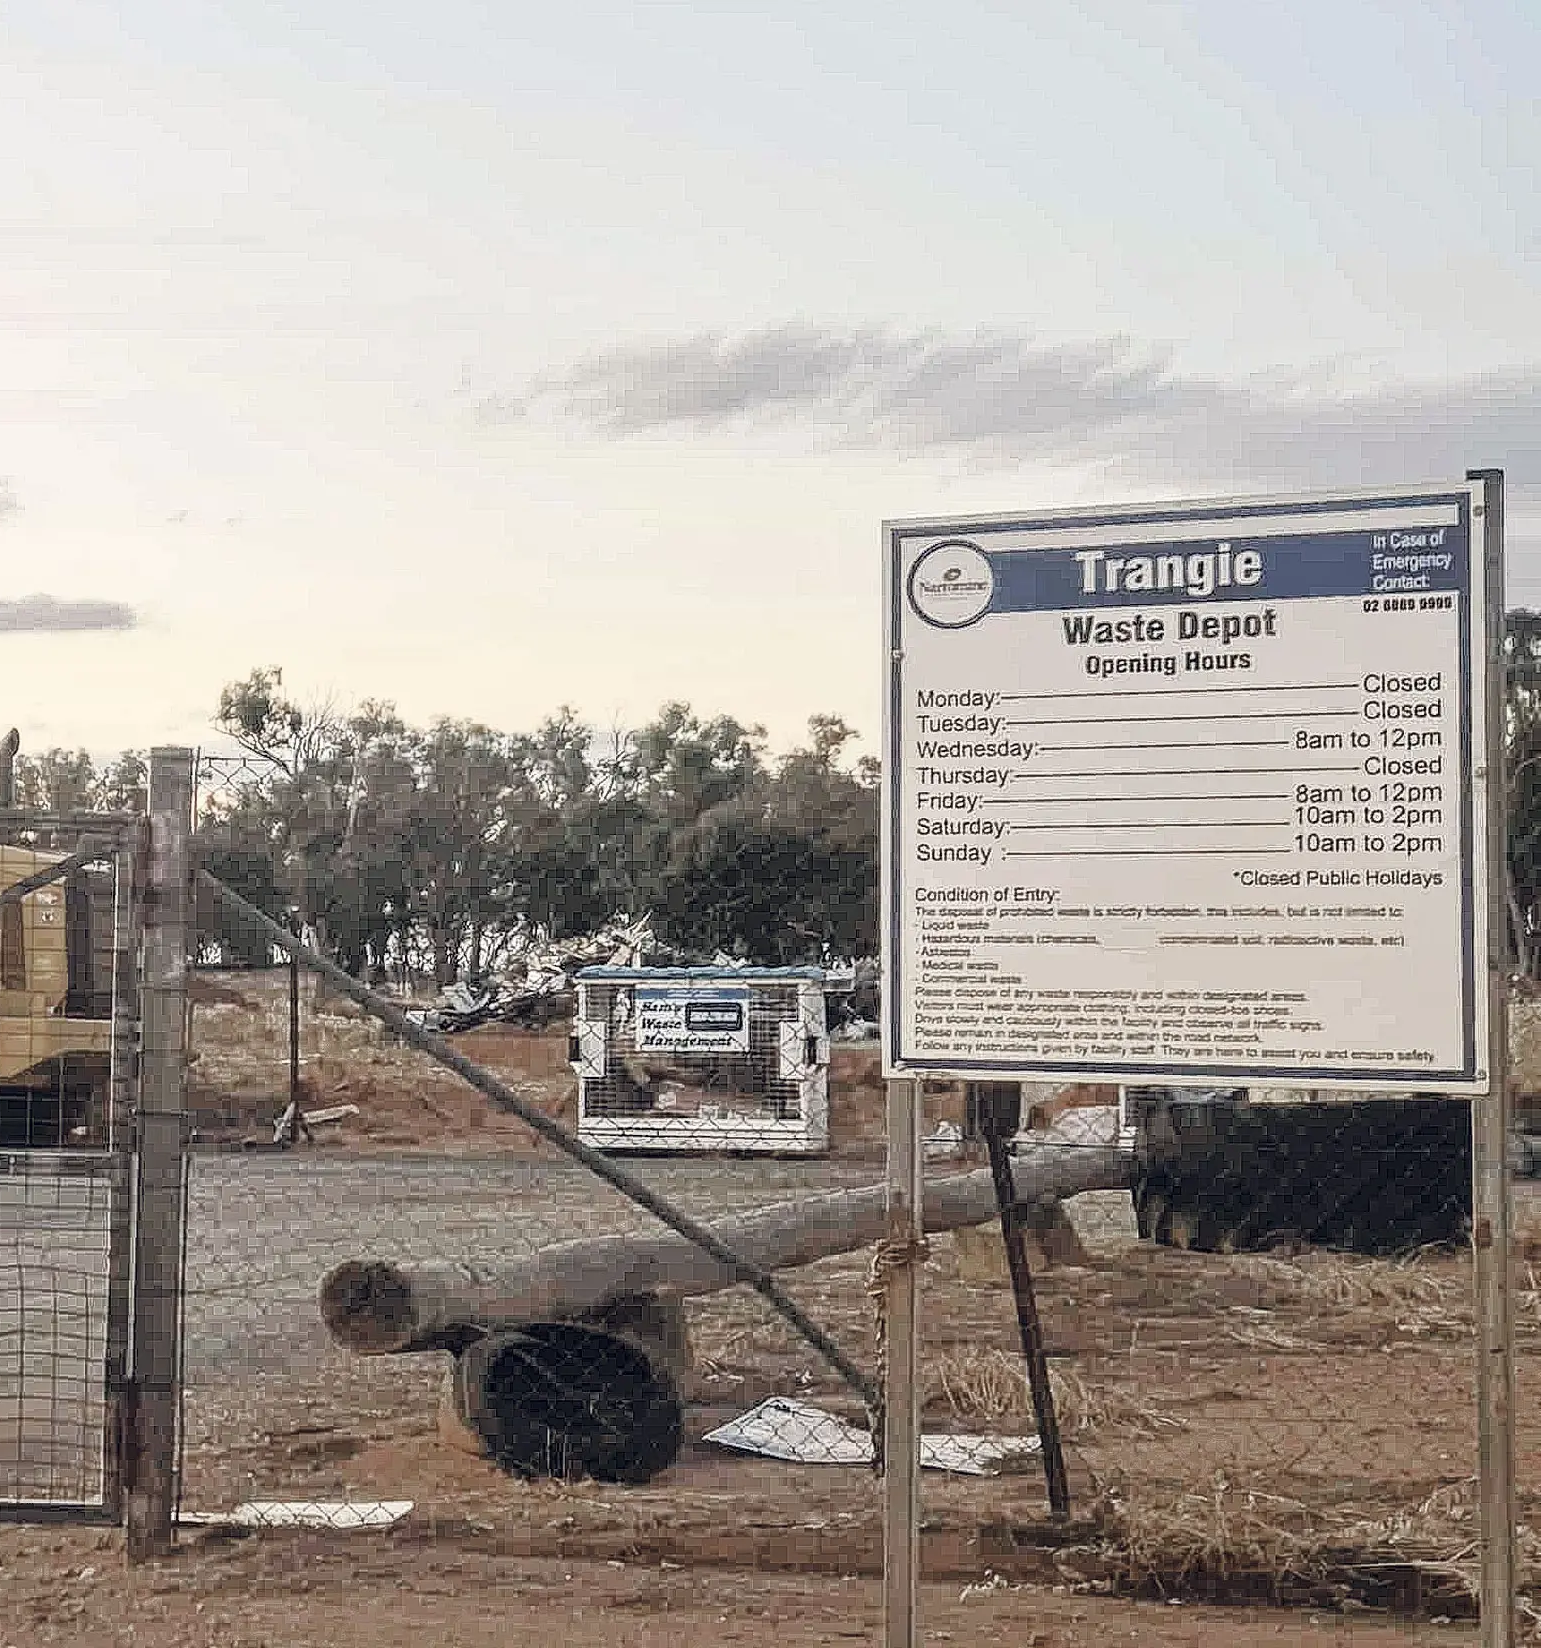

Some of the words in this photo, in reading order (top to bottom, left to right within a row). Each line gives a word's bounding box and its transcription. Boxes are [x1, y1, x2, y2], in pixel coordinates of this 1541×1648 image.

[1373, 534, 1387, 548] In
[1390, 532, 1426, 548] Case
[1429, 529, 1445, 546] of
[1072, 548, 1264, 598] Trangie
[1372, 552, 1452, 572] Emergency
[1063, 612, 1164, 646] Waste
[1179, 607, 1277, 645] Depot
[1086, 653, 1177, 679] Opening
[1184, 650, 1251, 672] Hours
[917, 688, 1001, 711] Monday:
[1364, 671, 1442, 693] Closed
[917, 714, 1006, 737] Tuesday:
[1364, 698, 1442, 721] Closed
[917, 739, 1040, 761] Wednesday:
[1295, 730, 1344, 751] 8am
[1350, 729, 1372, 749] to
[1379, 727, 1442, 754] 12pm
[917, 765, 1013, 787] Thursday:
[1364, 755, 1442, 776] Closed
[917, 791, 984, 813] Friday:
[1295, 783, 1345, 803] 8am
[1351, 783, 1375, 802] to
[1380, 782, 1443, 806] 12pm
[917, 816, 1011, 839] Saturday:
[1295, 805, 1357, 826] 10am
[1364, 805, 1386, 825] to
[1391, 805, 1443, 830] 2pm
[1295, 833, 1357, 855] 10am
[1364, 833, 1386, 854] to
[1392, 833, 1443, 859] 2pm
[1308, 870, 1361, 886] Public
[1366, 869, 1443, 889] Holidays
[915, 887, 988, 902] Condition
[994, 887, 1008, 902] of
[1014, 888, 1060, 904] Entry:
[922, 921, 955, 932] Liquid
[922, 934, 981, 944] Hazardous
[1141, 990, 1163, 999] and
[983, 1015, 1004, 1025] and
[1163, 1045, 1190, 1058] They
[1299, 1050, 1321, 1062] you
[1324, 1049, 1348, 1059] and
